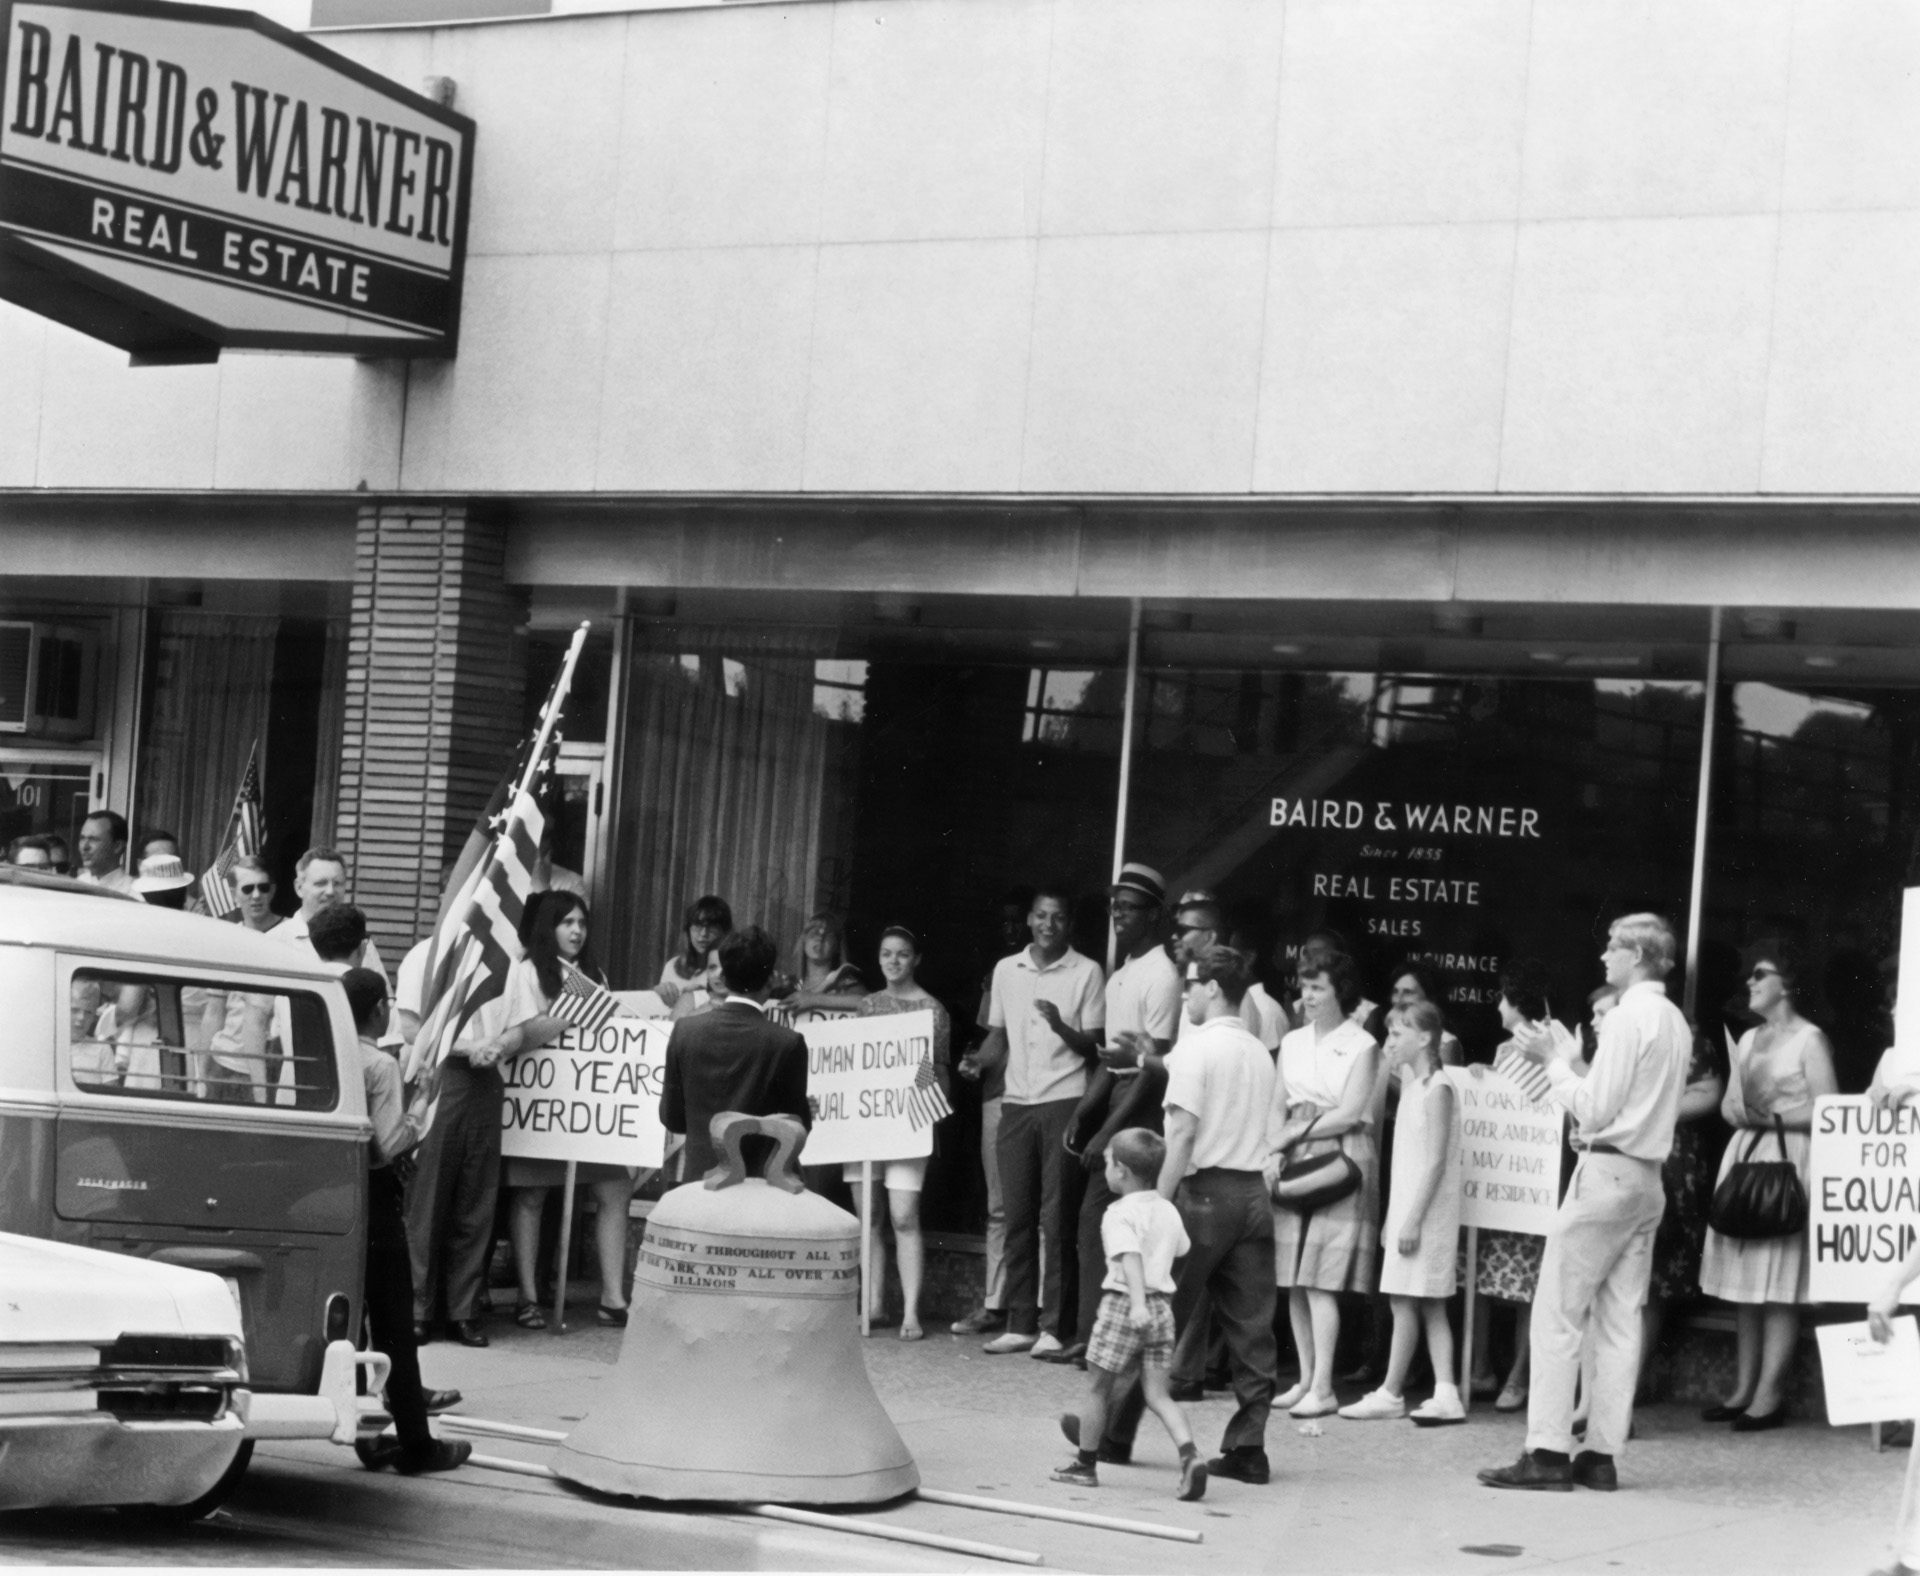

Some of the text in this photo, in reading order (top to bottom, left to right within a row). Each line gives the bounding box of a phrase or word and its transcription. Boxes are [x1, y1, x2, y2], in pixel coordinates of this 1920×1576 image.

[10, 20, 188, 175] BAIRD
[231, 80, 455, 247] WARNER
[91, 198, 370, 302] REAL ESTATE
[16, 785, 41, 807] 101
[1269, 798, 1541, 837] BAIRD & WARNER
[1313, 873, 1480, 905] REAL ESTATE
[1368, 918, 1422, 936] SALES
[809, 1043, 855, 1075] UMAN
[504, 1055, 666, 1097] 100 YEARS
[818, 1087, 906, 1122] UAL SERV
[1464, 1089, 1478, 1107] IN
[501, 1096, 640, 1139] OVERDUE
[1463, 1119, 1499, 1141] OVER
[1472, 1150, 1504, 1170] MAY
[1861, 1141, 1907, 1168] FOR
[1822, 1176, 1920, 1214] EQUA
[705, 1245, 796, 1260] THROUGHOUT
[805, 1250, 831, 1261] ALL
[673, 1275, 737, 1288] ILLINOIS
[705, 1264, 738, 1278] AND
[748, 1268, 776, 1280] ALL
[784, 1268, 823, 1280] OVER
